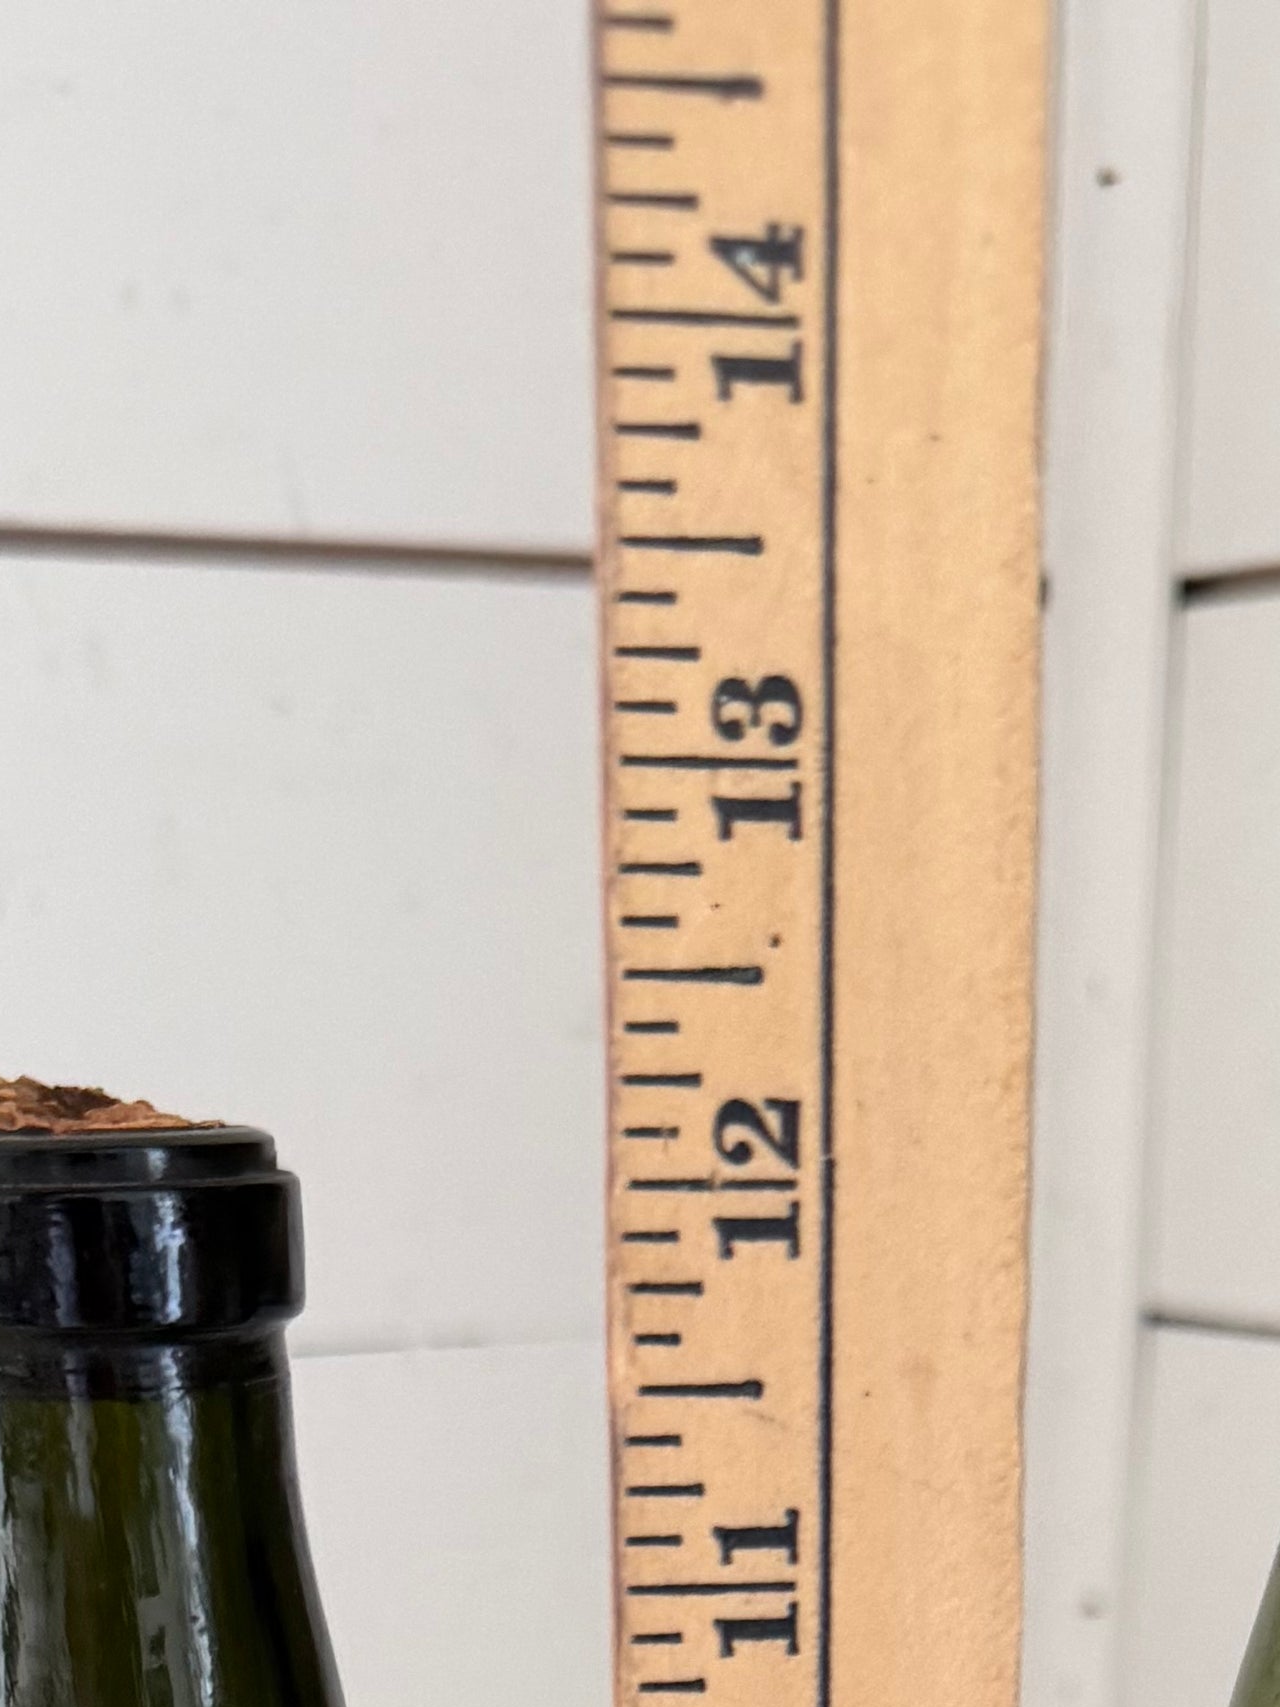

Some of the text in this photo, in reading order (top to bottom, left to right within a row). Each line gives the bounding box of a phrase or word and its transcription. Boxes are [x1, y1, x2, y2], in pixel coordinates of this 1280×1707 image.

[709, 222, 804, 403] 14
[710, 673, 803, 840] 13
[712, 1096, 801, 1260] 12
[712, 1507, 800, 1658] 11
